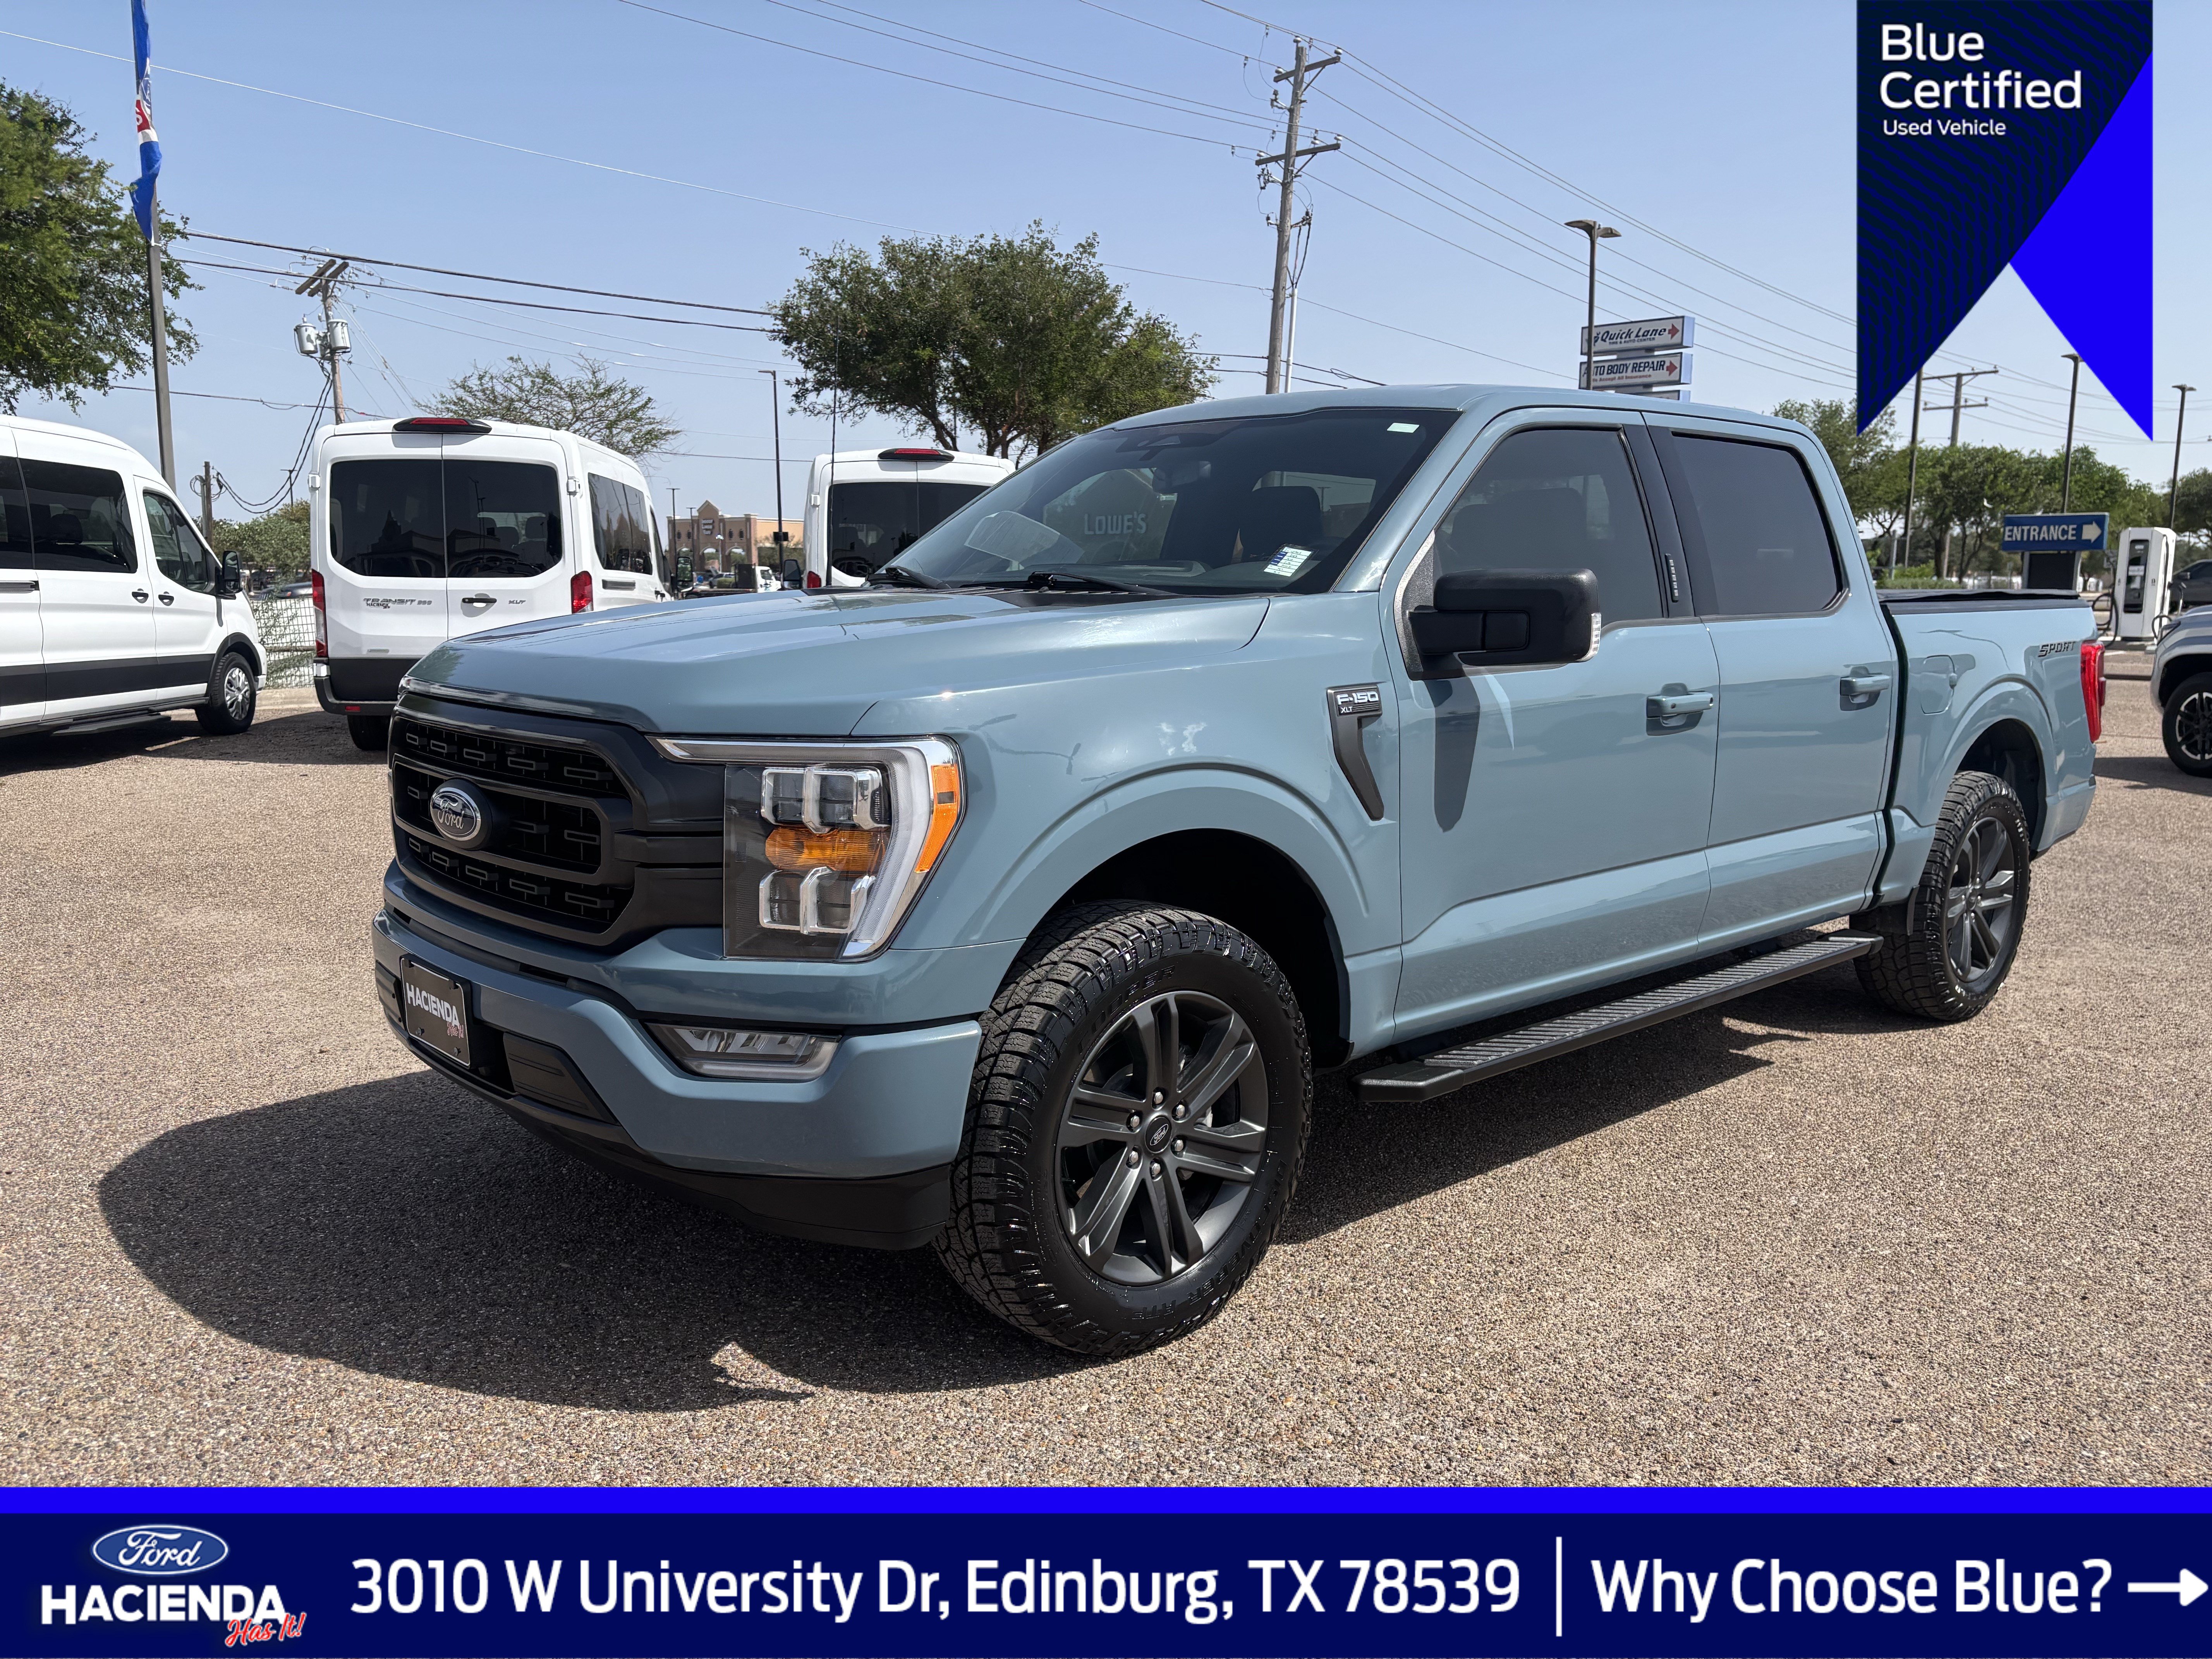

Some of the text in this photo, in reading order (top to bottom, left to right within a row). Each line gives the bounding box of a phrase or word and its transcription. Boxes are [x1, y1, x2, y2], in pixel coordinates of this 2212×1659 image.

[1601, 327, 1667, 342] Quick Lane
[1607, 363, 1631, 375] BODY
[1632, 360, 1666, 373] REPAIR
[1084, 511, 1146, 535] LOWE'S
[2004, 525, 2077, 541] ENTRANCE
[2038, 641, 2076, 657] SPORT
[1337, 691, 1379, 705] F-150
[438, 798, 464, 829] Ford
[406, 982, 460, 1029] HACIENDA
[1079, 965, 1175, 1055] COOPER
[1154, 1127, 1165, 1143] Ford
